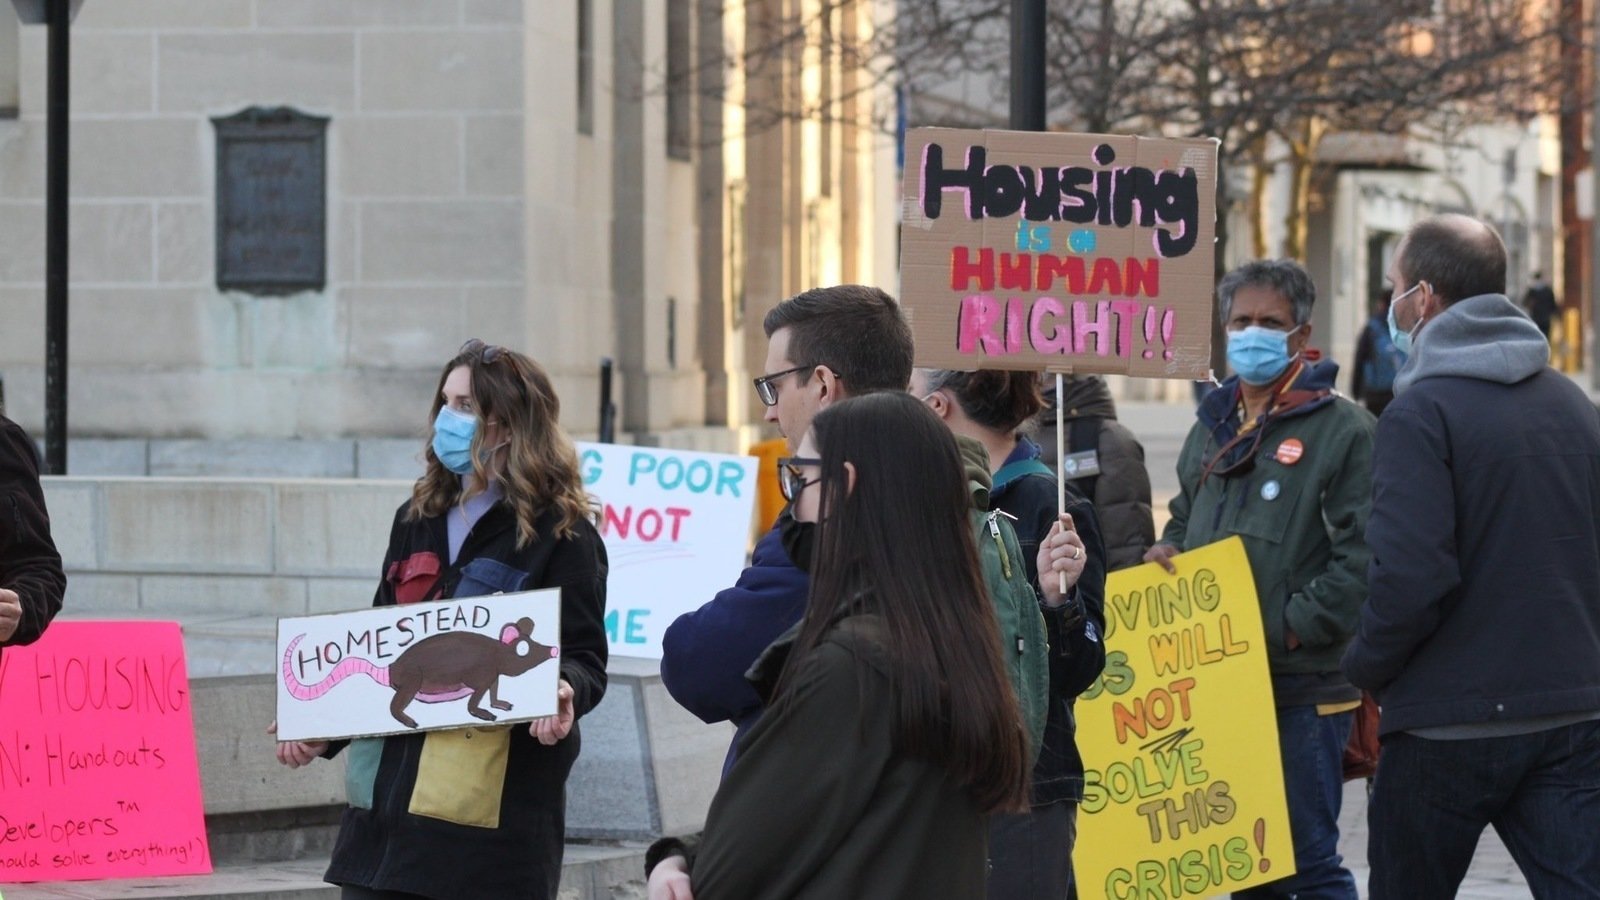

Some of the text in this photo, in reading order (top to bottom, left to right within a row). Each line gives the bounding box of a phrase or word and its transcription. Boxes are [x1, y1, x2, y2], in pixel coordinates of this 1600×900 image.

[919, 142, 1199, 258] Housing
[1015, 219, 1097, 254] is a
[951, 246, 1160, 298] HUMAN
[956, 294, 1177, 361] RIGHT!!
[628, 452, 745, 498] POOR
[602, 504, 691, 542] NOT
[299, 604, 491, 679] HOMESTEAD
[1149, 613, 1250, 677] WILL
[35, 653, 187, 715] HOUSING
[1112, 677, 1196, 744] NOT
[44, 733, 166, 788] Handouts
[1080, 738, 1209, 815] SOLVE
[1136, 780, 1237, 844] THIS
[52, 849, 94, 869] solve
[1104, 817, 1271, 900] CRISIS!
